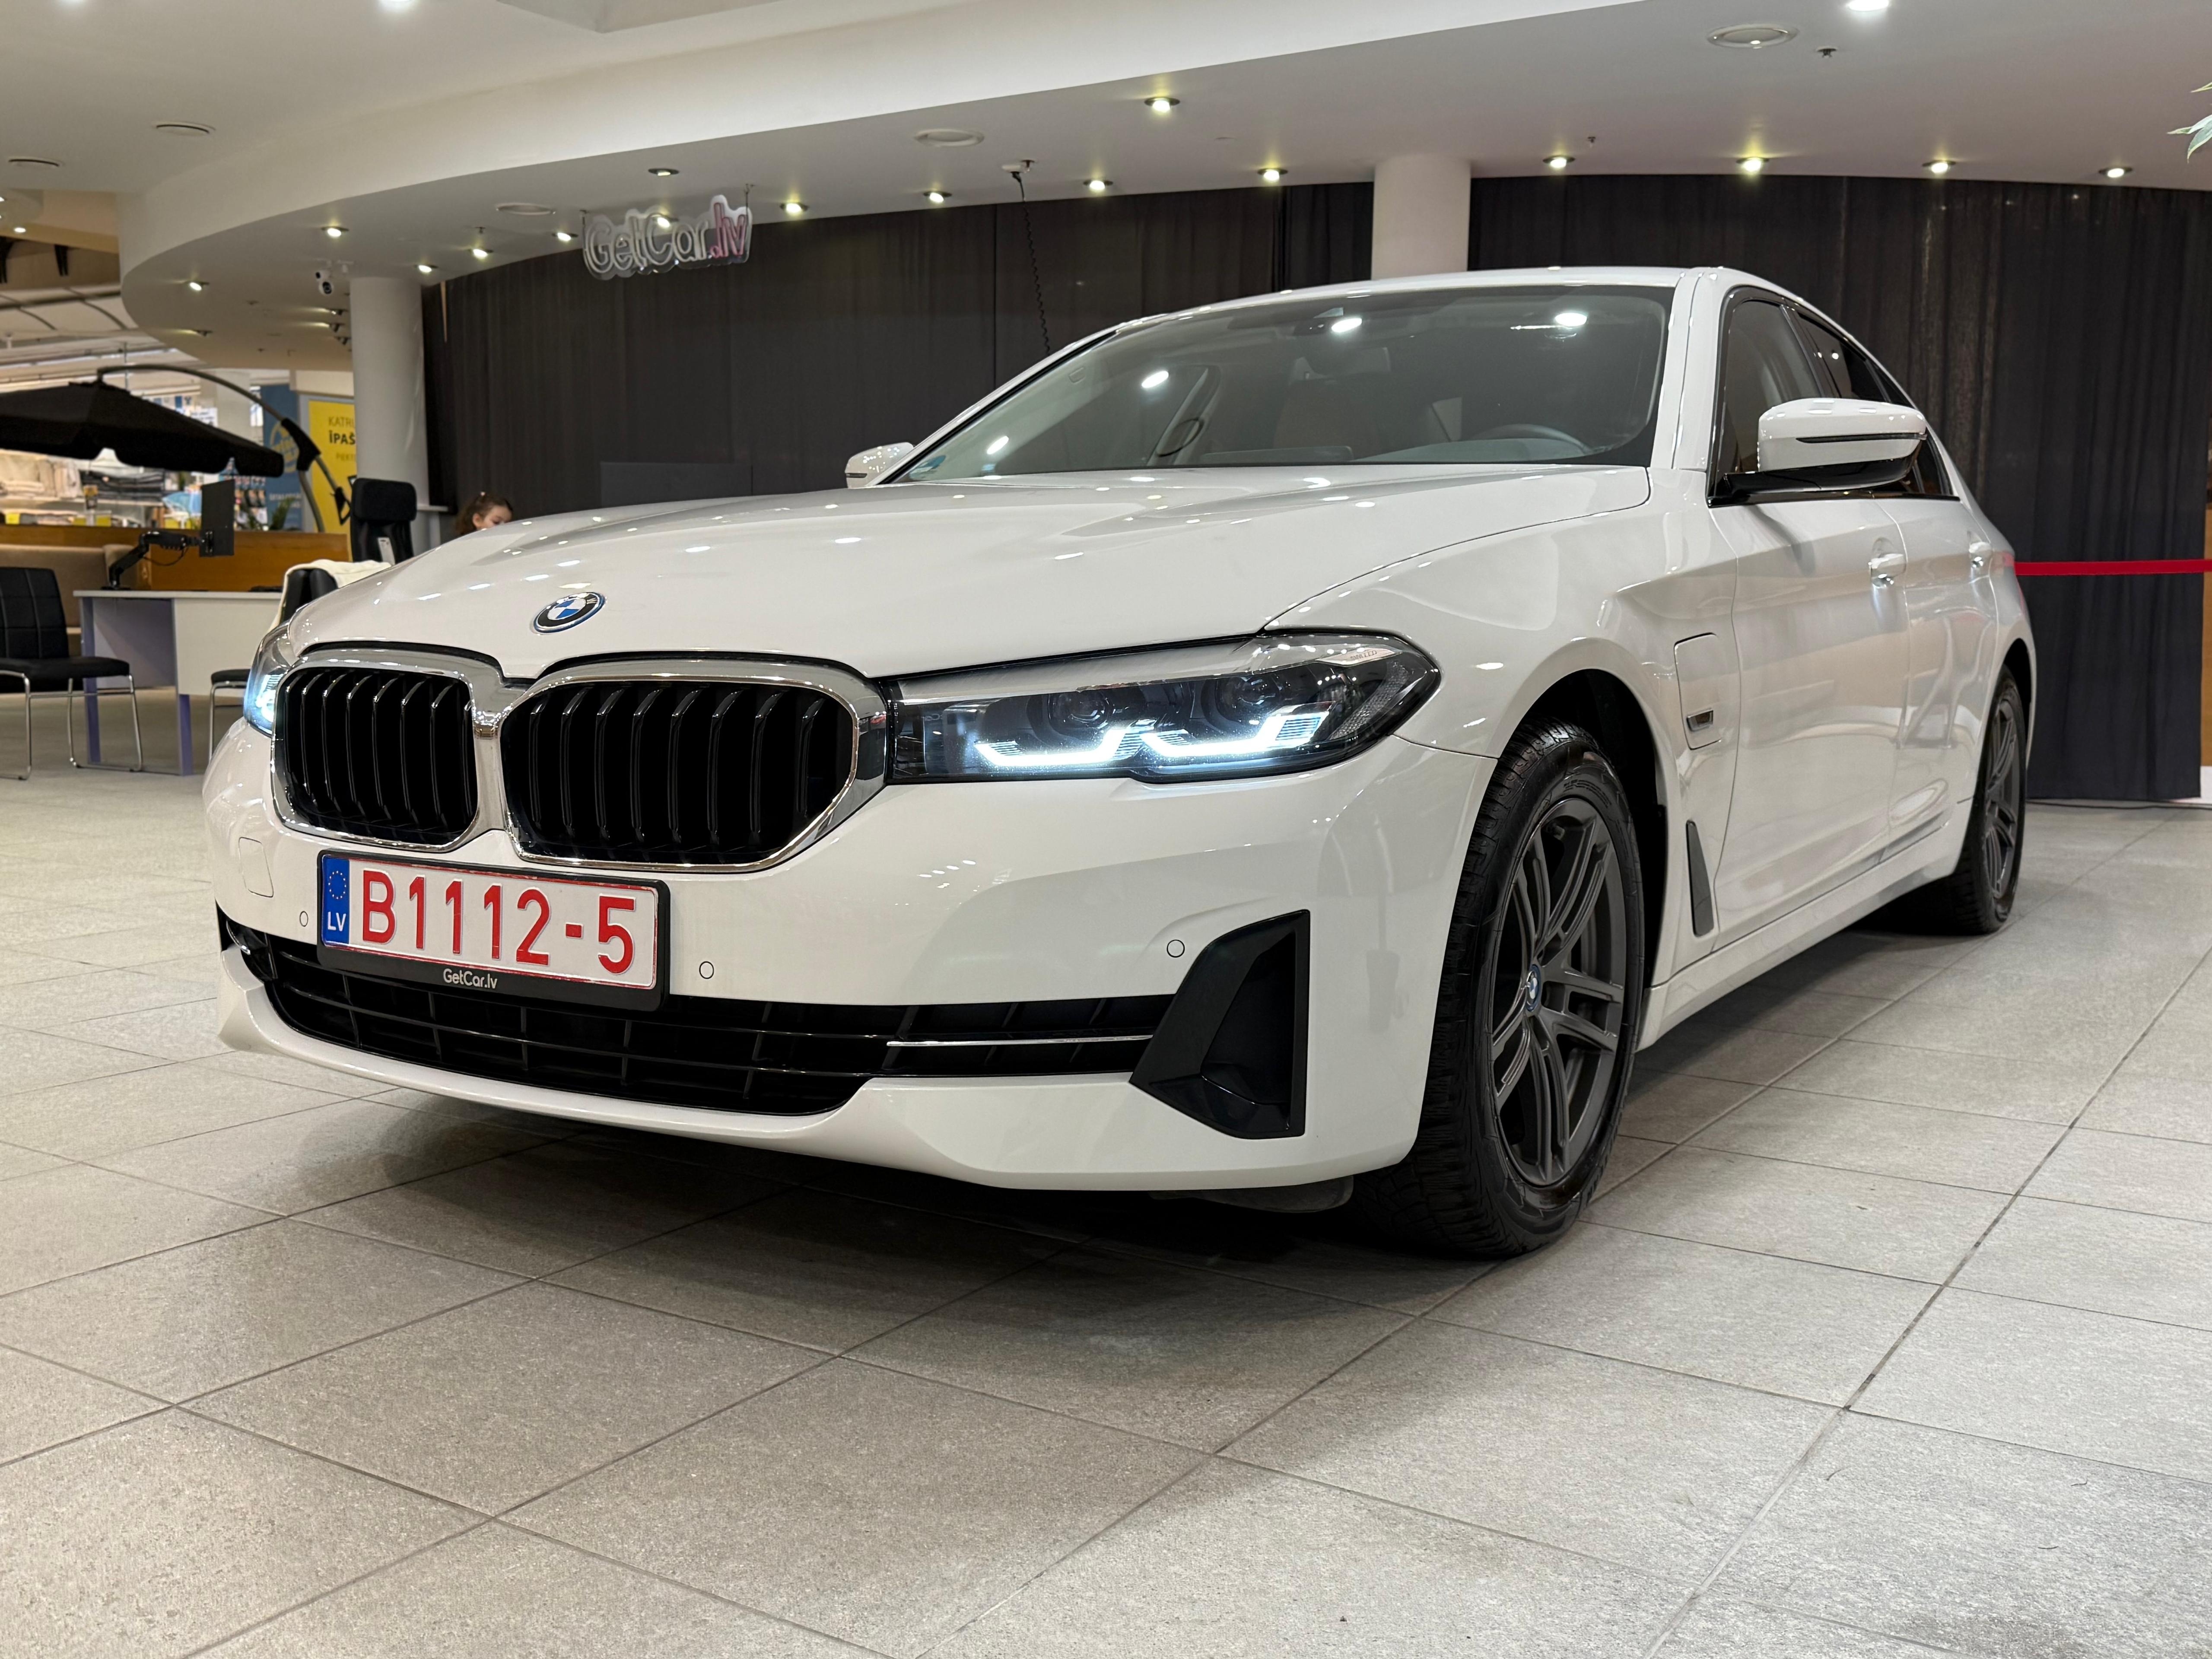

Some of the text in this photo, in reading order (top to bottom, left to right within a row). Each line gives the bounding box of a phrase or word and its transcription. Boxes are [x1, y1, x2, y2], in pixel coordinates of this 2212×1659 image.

[585, 202, 746, 273] GetCar.lv
[328, 912, 346, 931] LV
[363, 870, 634, 974] B1112-5
[443, 968, 497, 988] GetCar.lv
